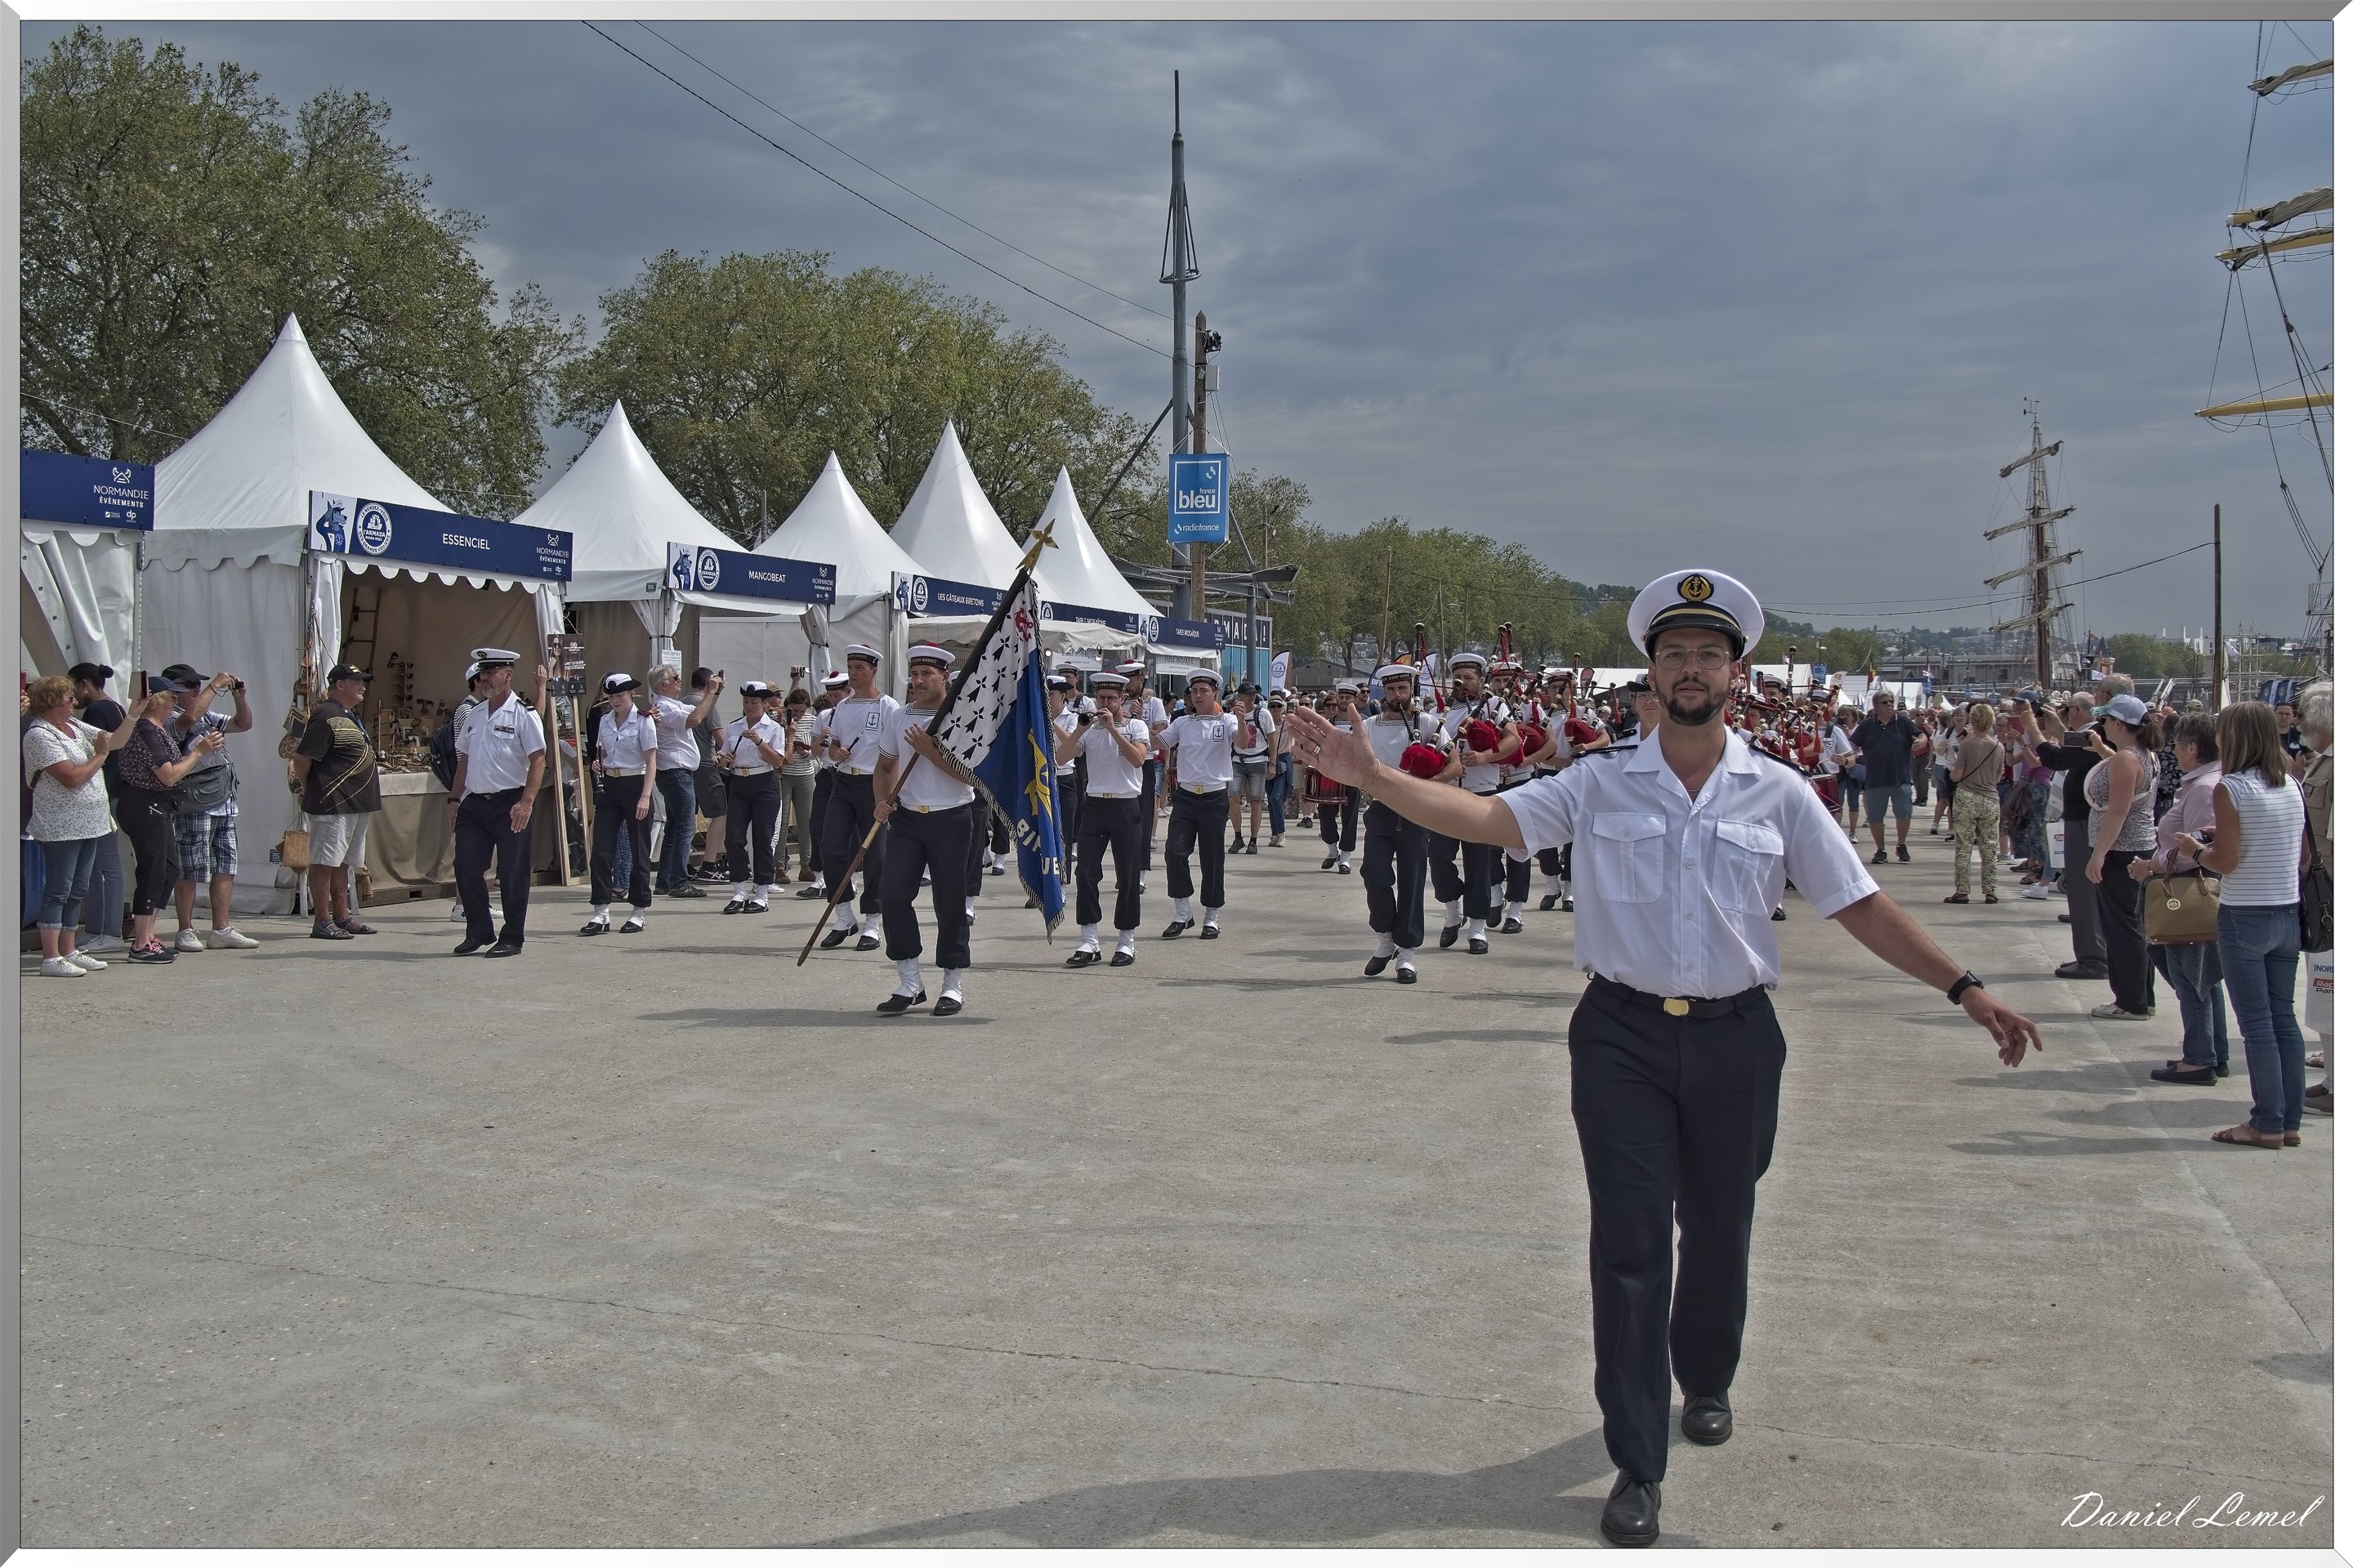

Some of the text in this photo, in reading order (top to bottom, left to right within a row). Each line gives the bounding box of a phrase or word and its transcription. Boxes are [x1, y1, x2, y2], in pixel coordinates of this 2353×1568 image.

[93, 485, 150, 500] NORMANDIE
[99, 495, 145, 508] ÉVÉNEMENTS
[1179, 490, 1216, 509] bleu
[1182, 523, 1220, 531] radiofrance
[442, 533, 491, 551] ESSENCIEL
[536, 547, 569, 559] NORMANDIE
[748, 570, 786, 583] MANGOBEAT
[937, 592, 946, 601] LES
[946, 592, 965, 605] GÂTEAUX
[965, 599, 985, 607] BRETONS
[1176, 628, 1185, 637] TABLE
